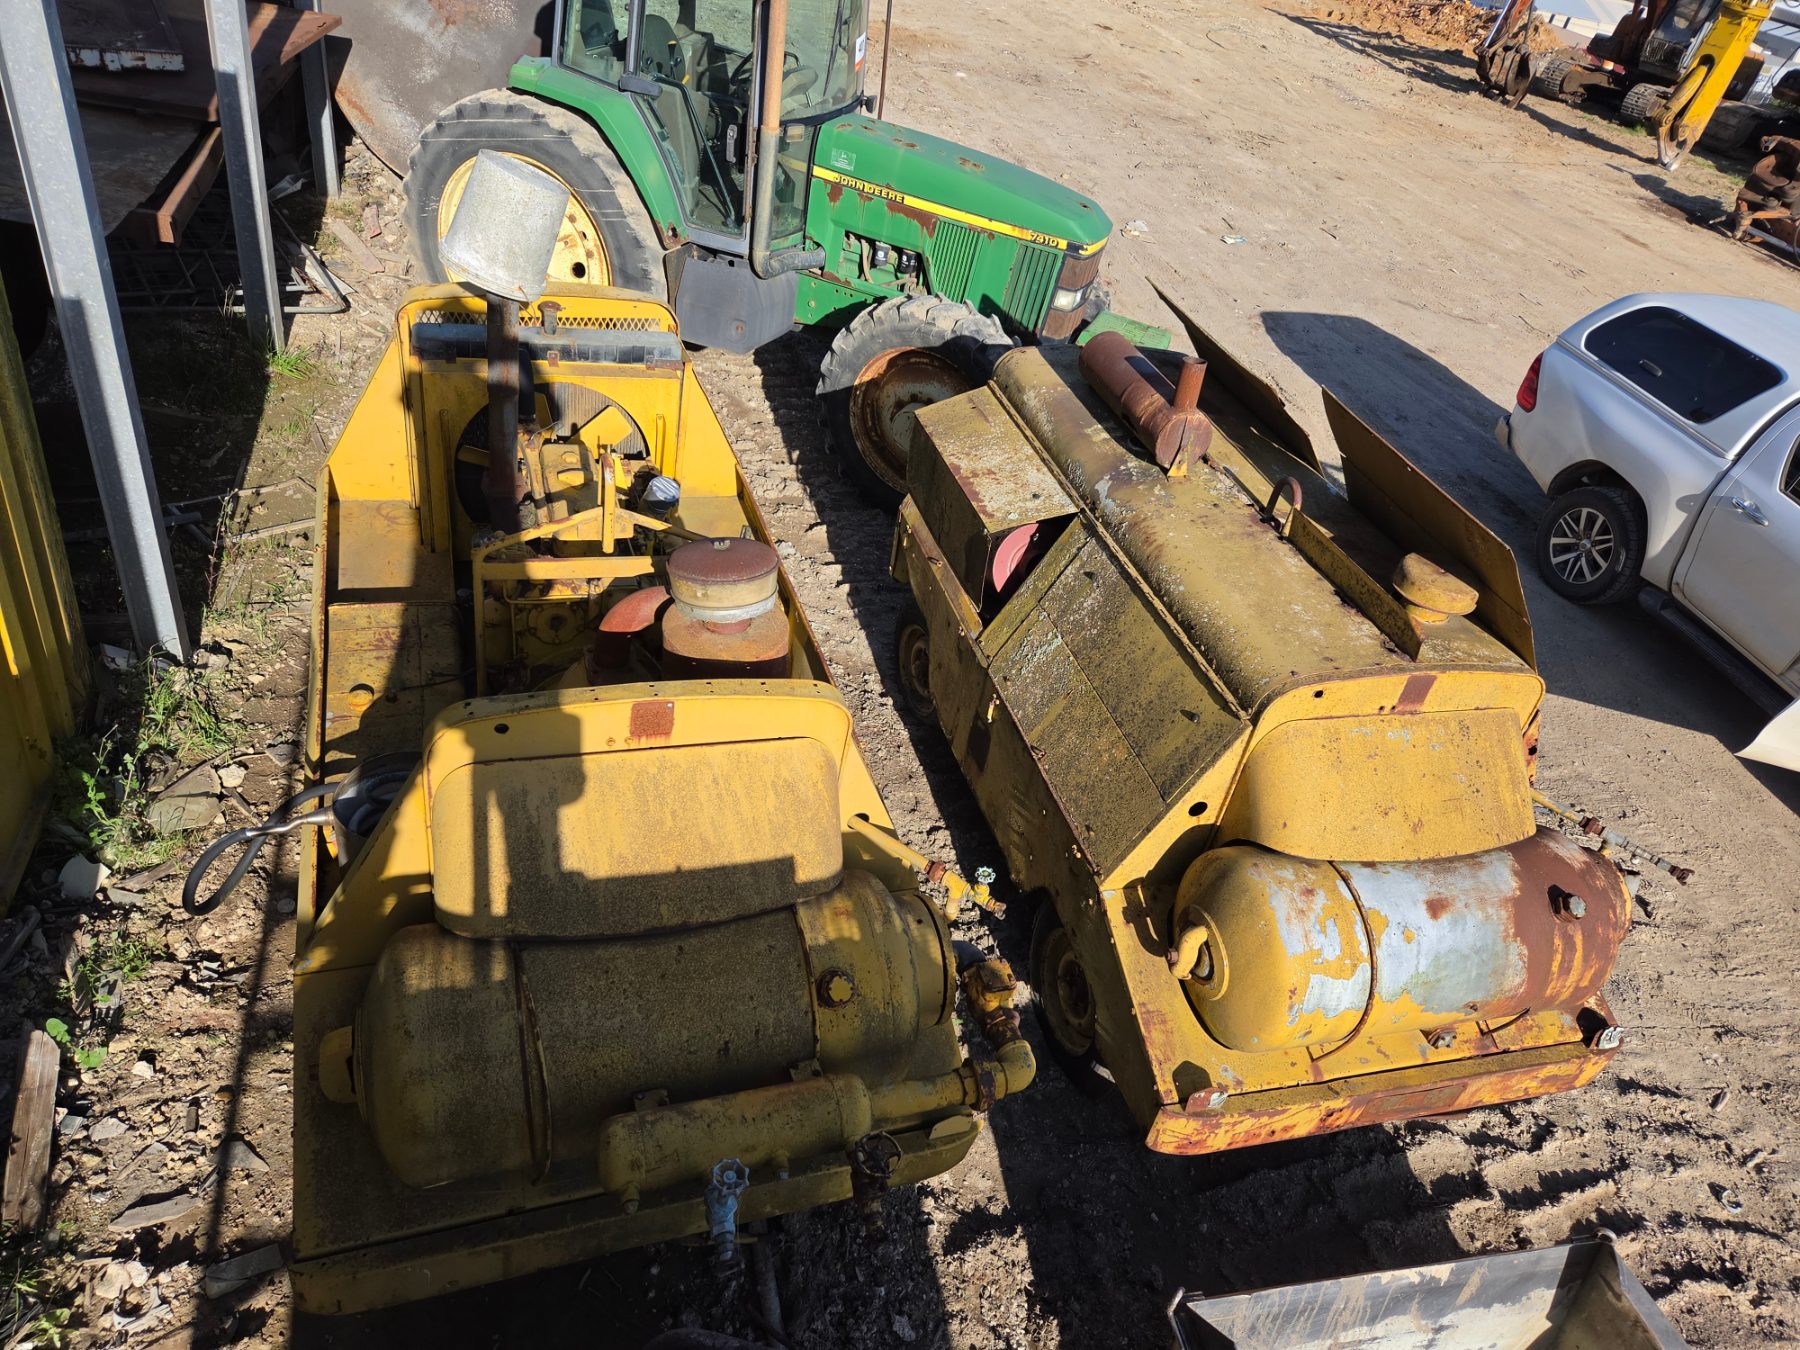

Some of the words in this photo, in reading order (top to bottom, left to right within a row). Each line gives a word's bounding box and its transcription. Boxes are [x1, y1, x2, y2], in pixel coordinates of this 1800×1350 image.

[833, 174, 864, 191] JOHN
[864, 183, 904, 203] DEERE
[1030, 232, 1059, 247] 7410
